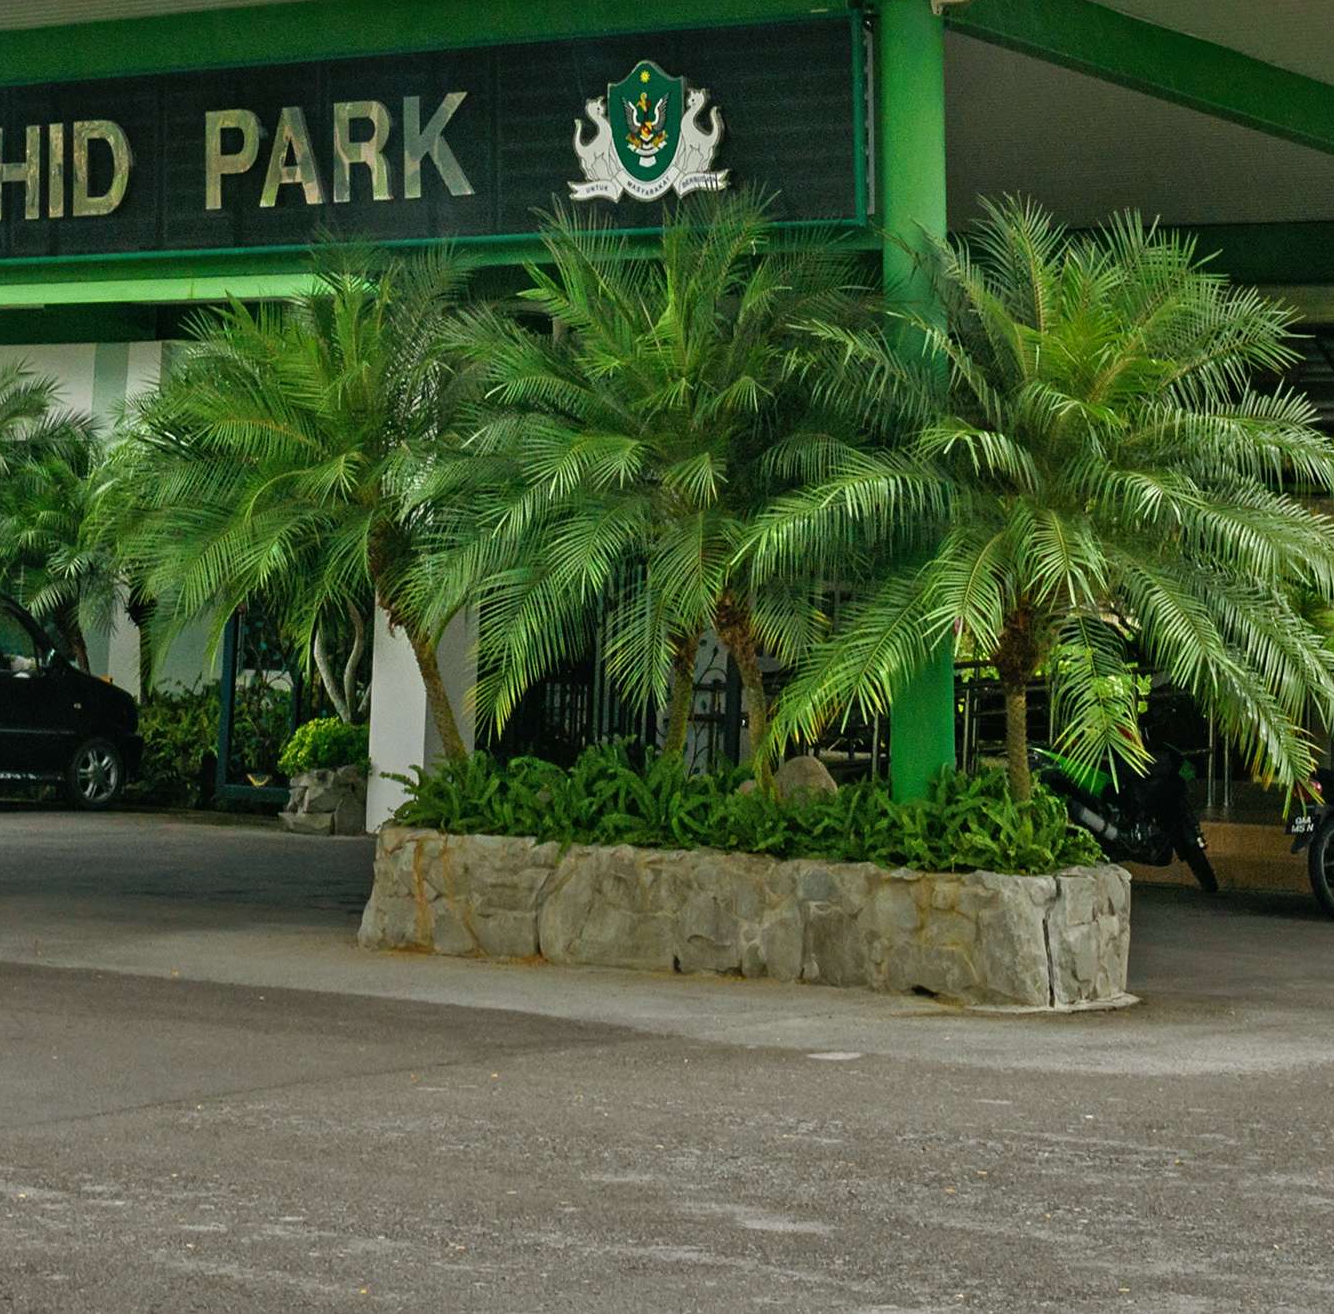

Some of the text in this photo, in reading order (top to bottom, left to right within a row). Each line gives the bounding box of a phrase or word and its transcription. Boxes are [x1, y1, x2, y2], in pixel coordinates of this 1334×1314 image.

[205, 91, 475, 210] PARK
[585, 185, 609, 194] UNTUK
[627, 175, 671, 196] MASYARAKAT
